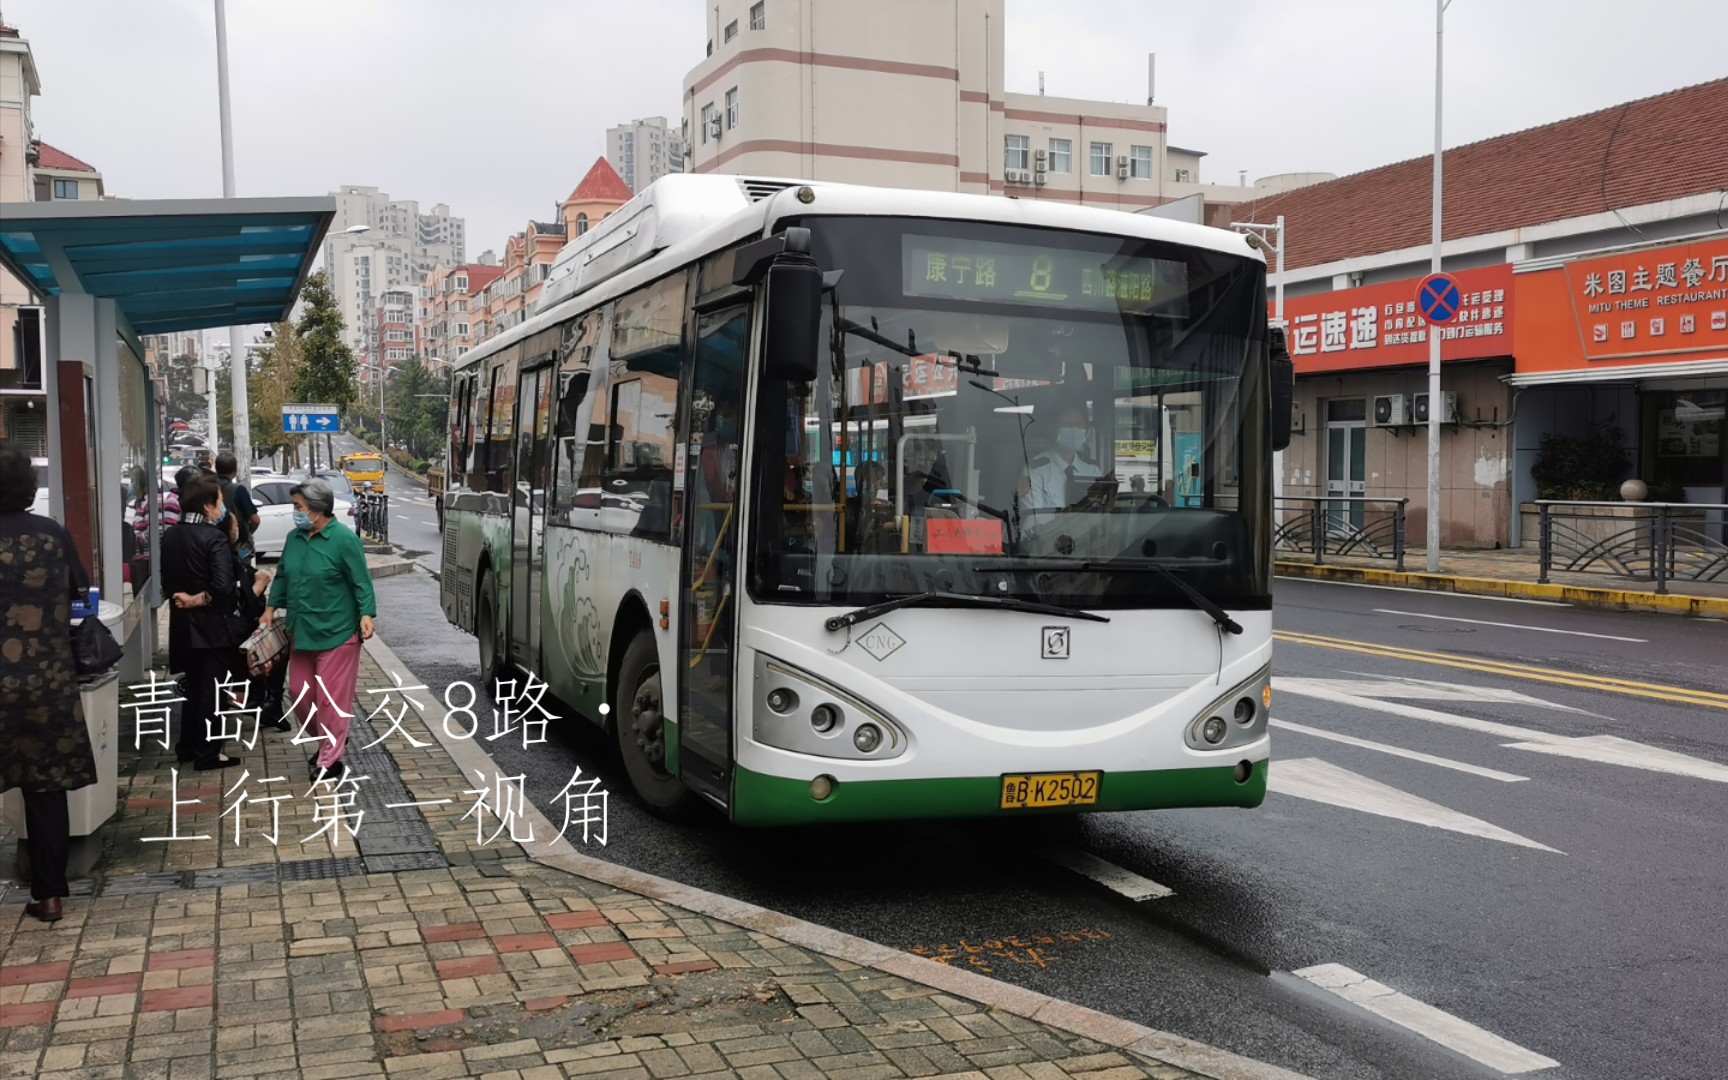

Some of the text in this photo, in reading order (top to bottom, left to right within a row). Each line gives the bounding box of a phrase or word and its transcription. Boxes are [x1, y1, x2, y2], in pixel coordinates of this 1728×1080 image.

[926, 253, 997, 288] 康宁路
[1030, 256, 1053, 292] 8
[1584, 255, 1728, 298] 米图主题餐厅
[1588, 289, 1728, 314] MITU THEME RESTAURANT
[1283, 305, 1378, 355] 运速递
[866, 635, 897, 650] CNG
